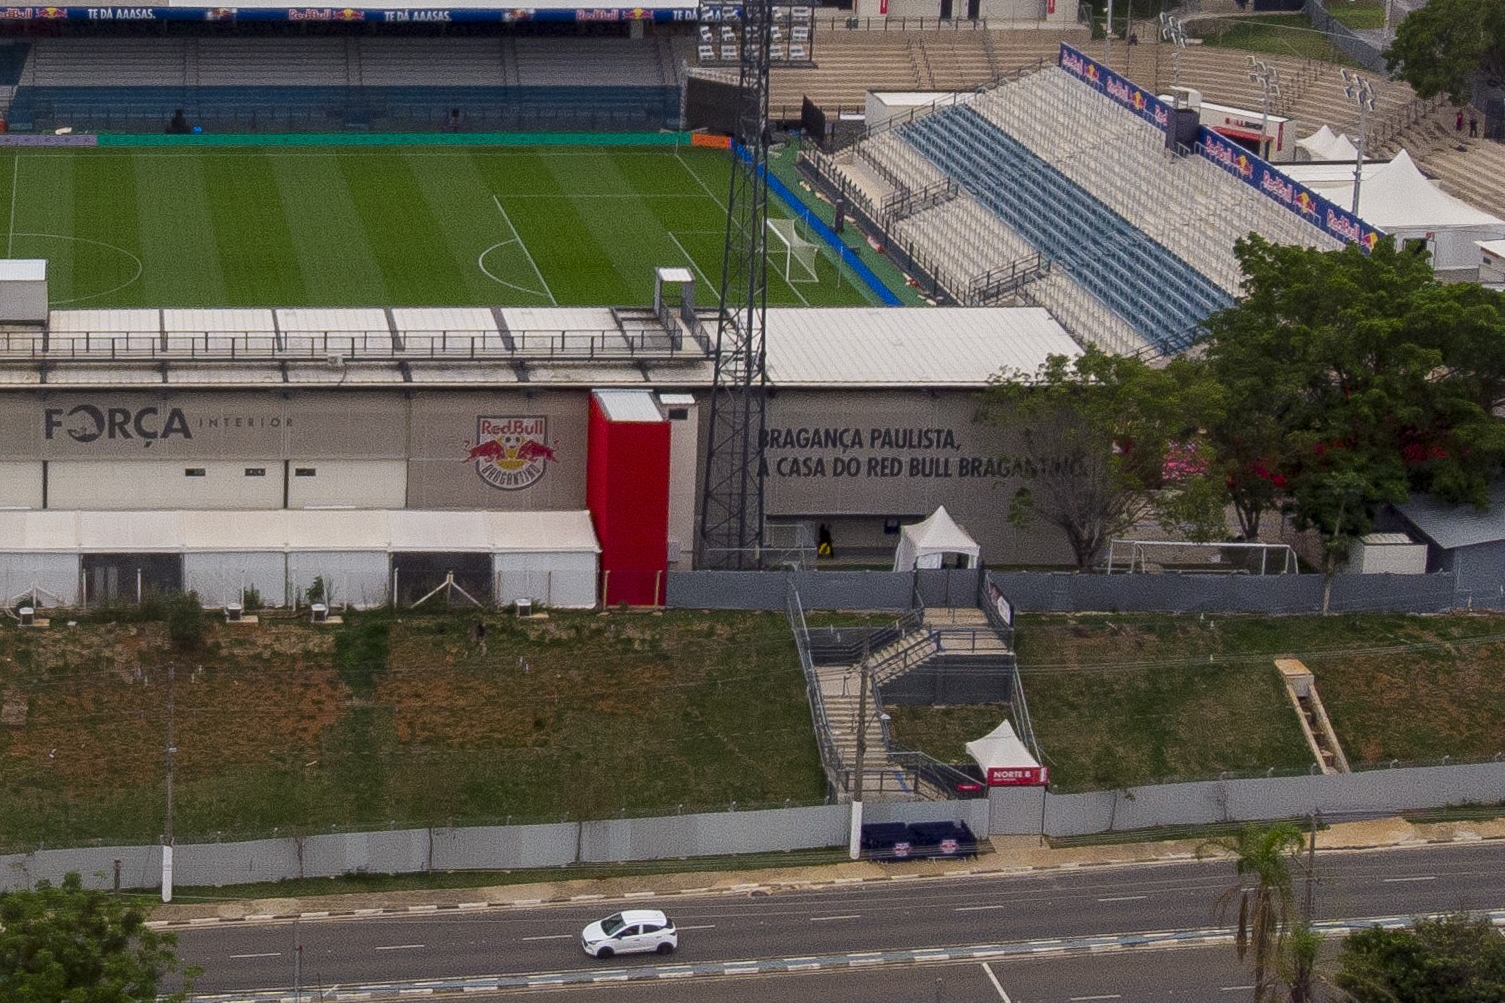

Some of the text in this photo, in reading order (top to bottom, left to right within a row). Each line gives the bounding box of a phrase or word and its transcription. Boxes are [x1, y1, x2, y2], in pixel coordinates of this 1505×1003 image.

[88, 8, 98, 19] TE
[385, 10, 395, 21] TE
[673, 9, 683, 21] TE
[44, 404, 294, 448] FORÇA INTERIOR
[757, 427, 962, 454] BRAGANÇA PAULISTA,
[776, 456, 826, 477] CASA
[832, 456, 861, 477] DO
[867, 456, 904, 477] RED
[909, 456, 953, 477] BULL
[994, 770, 1023, 779] NORTE
